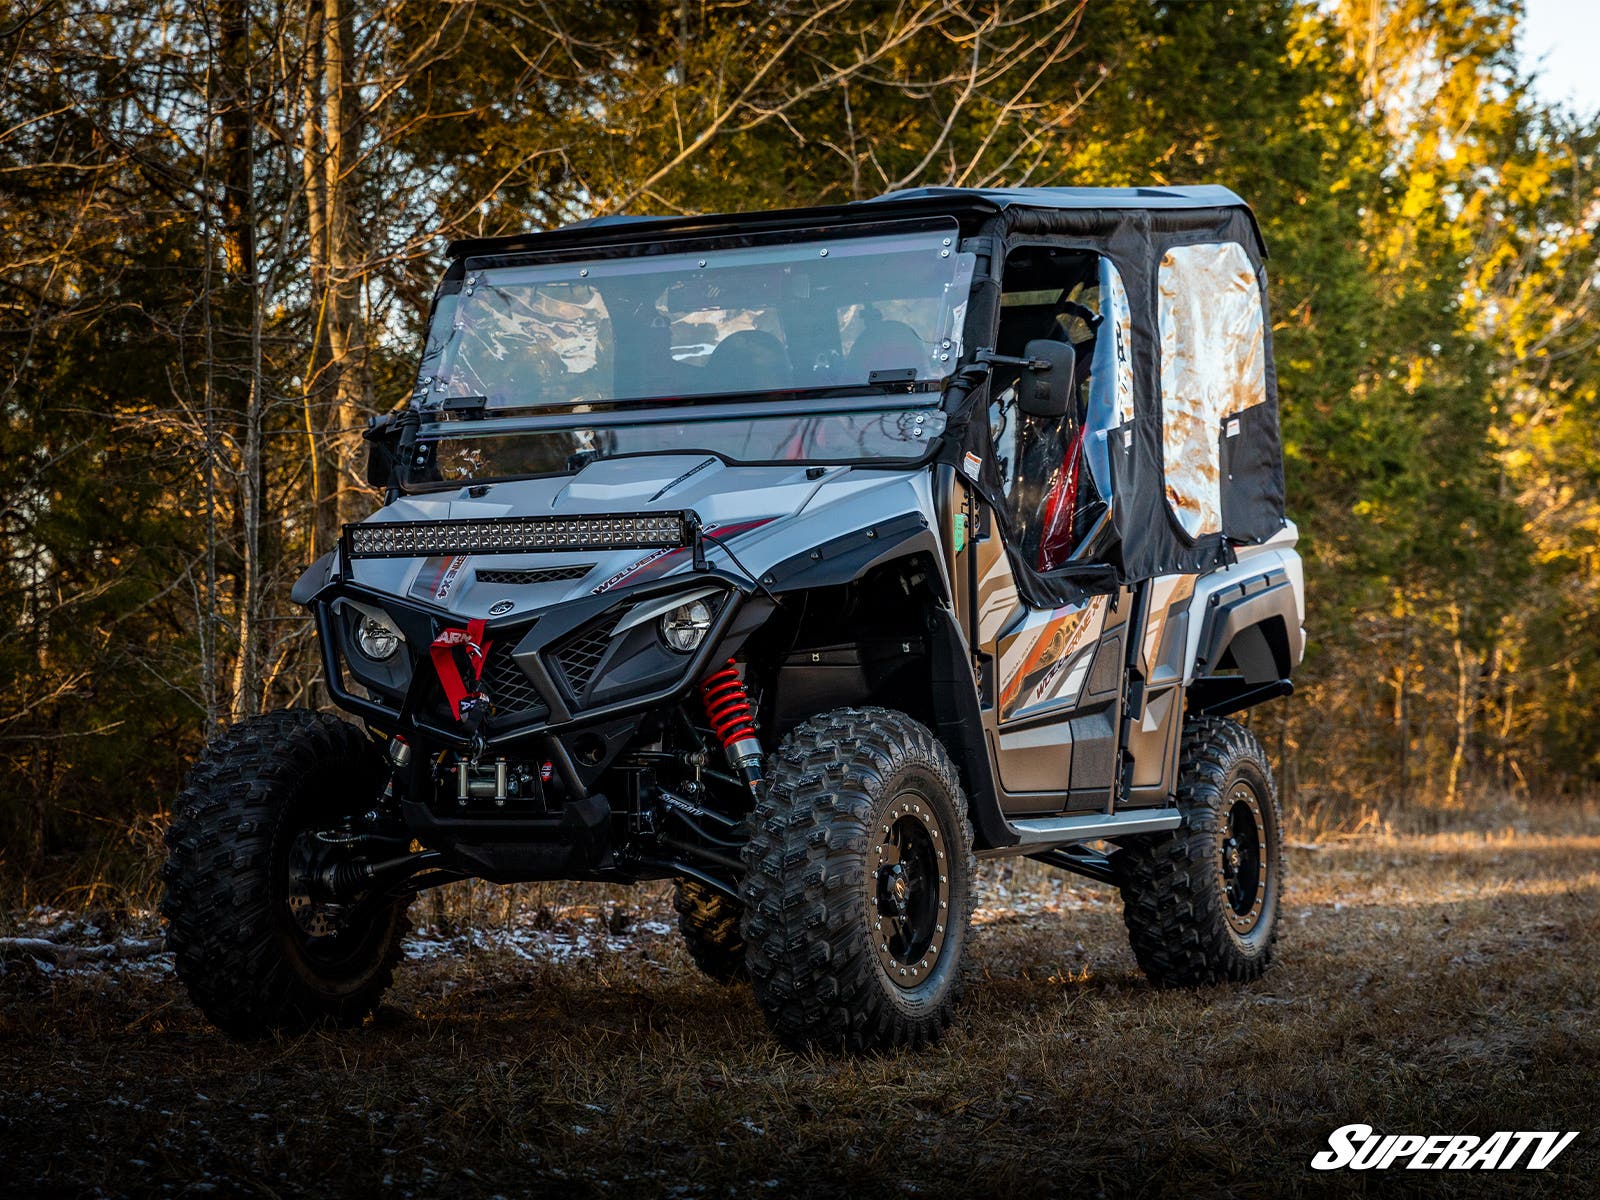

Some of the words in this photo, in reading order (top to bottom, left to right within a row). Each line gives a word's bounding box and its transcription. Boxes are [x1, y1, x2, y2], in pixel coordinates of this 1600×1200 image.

[446, 555, 468, 579] ERINE
[591, 547, 670, 594] WOLVERI
[434, 631, 472, 644] ARN
